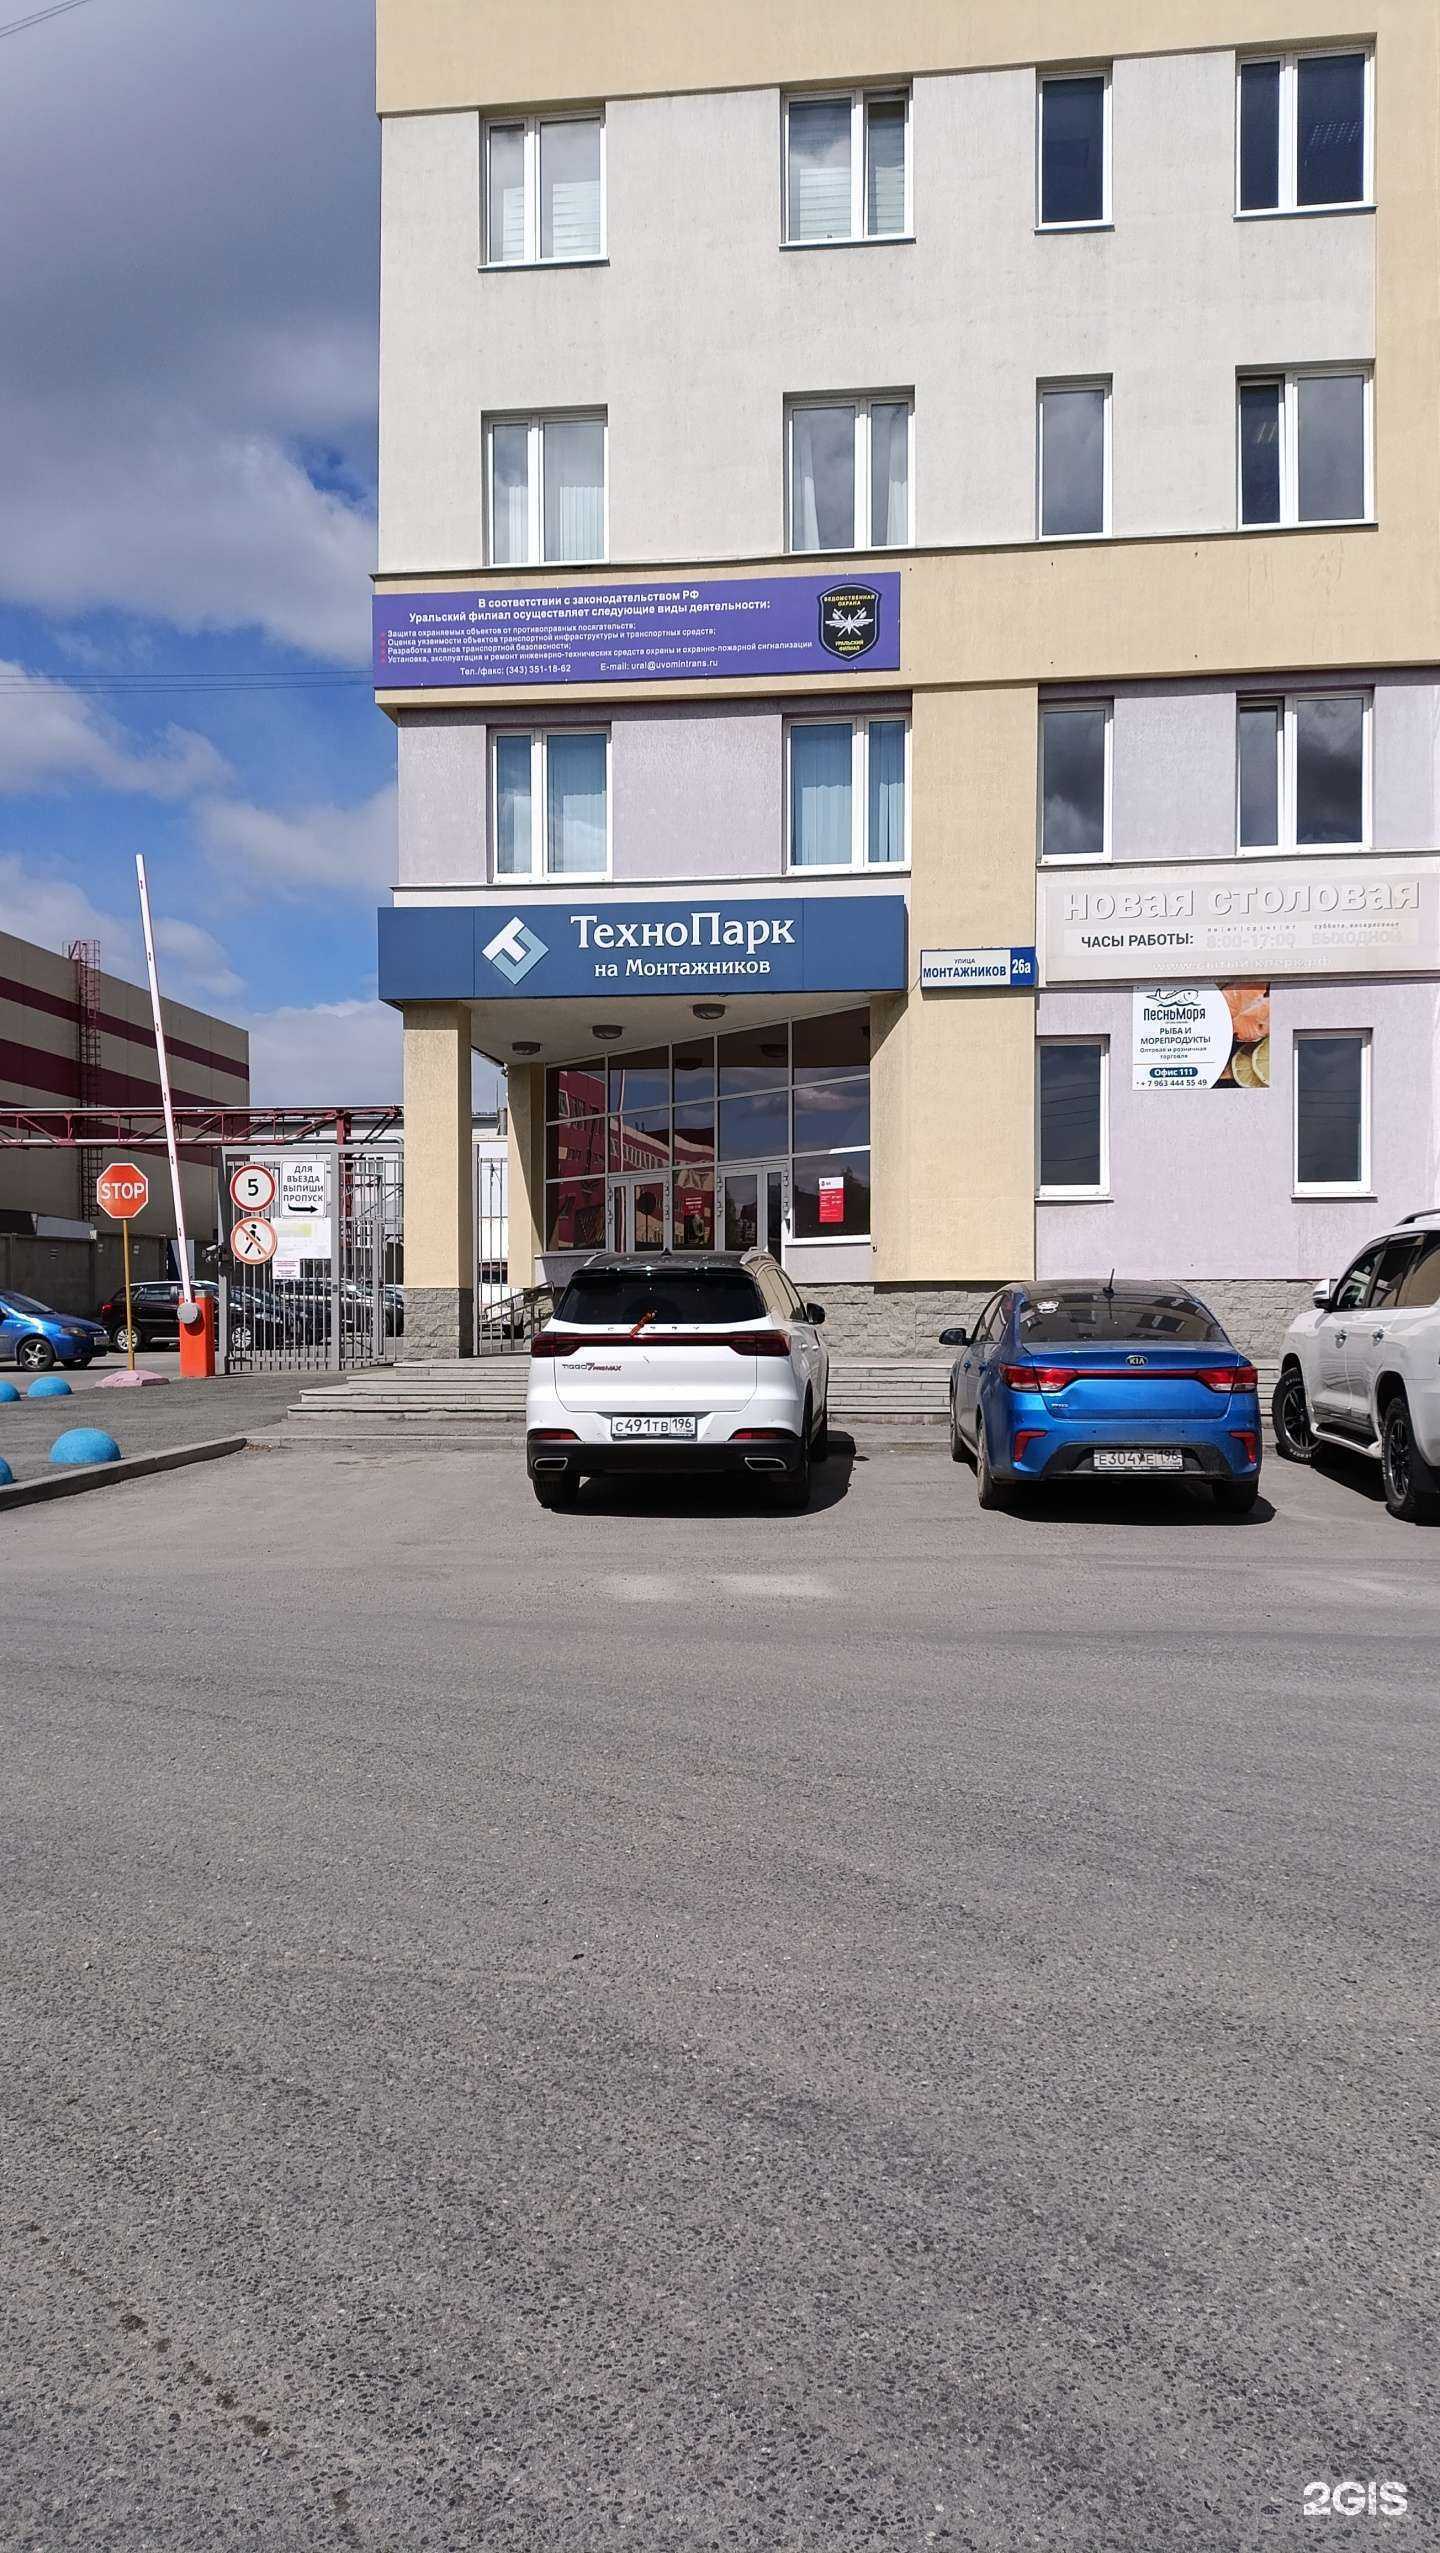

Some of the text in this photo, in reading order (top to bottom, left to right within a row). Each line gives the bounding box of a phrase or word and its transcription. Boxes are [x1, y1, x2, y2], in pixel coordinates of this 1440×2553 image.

[478, 590, 700, 608] В соответствии с законодательством РФ
[409, 601, 771, 624] Уральский филиал осуществляет следующие виды деятельности:
[506, 665, 528, 675] (343)
[529, 664, 571, 673] 351-18-62
[600, 662, 630, 671] E-mail:
[569, 911, 796, 955] ТехноПарк
[1082, 933, 1194, 948] ЧАСЫ РАБОТЫ:
[594, 957, 771, 978] на Монтажников
[923, 966, 1006, 978] МОНТАЖНИКОВ
[1143, 1007, 1206, 1021] ПесньМоря
[1140, 1036, 1211, 1045] МОРЕПРОДУКТЫ
[1154, 1068, 1178, 1077] Офис
[100, 1182, 145, 1200] STOP
[247, 1178, 260, 1196] 5
